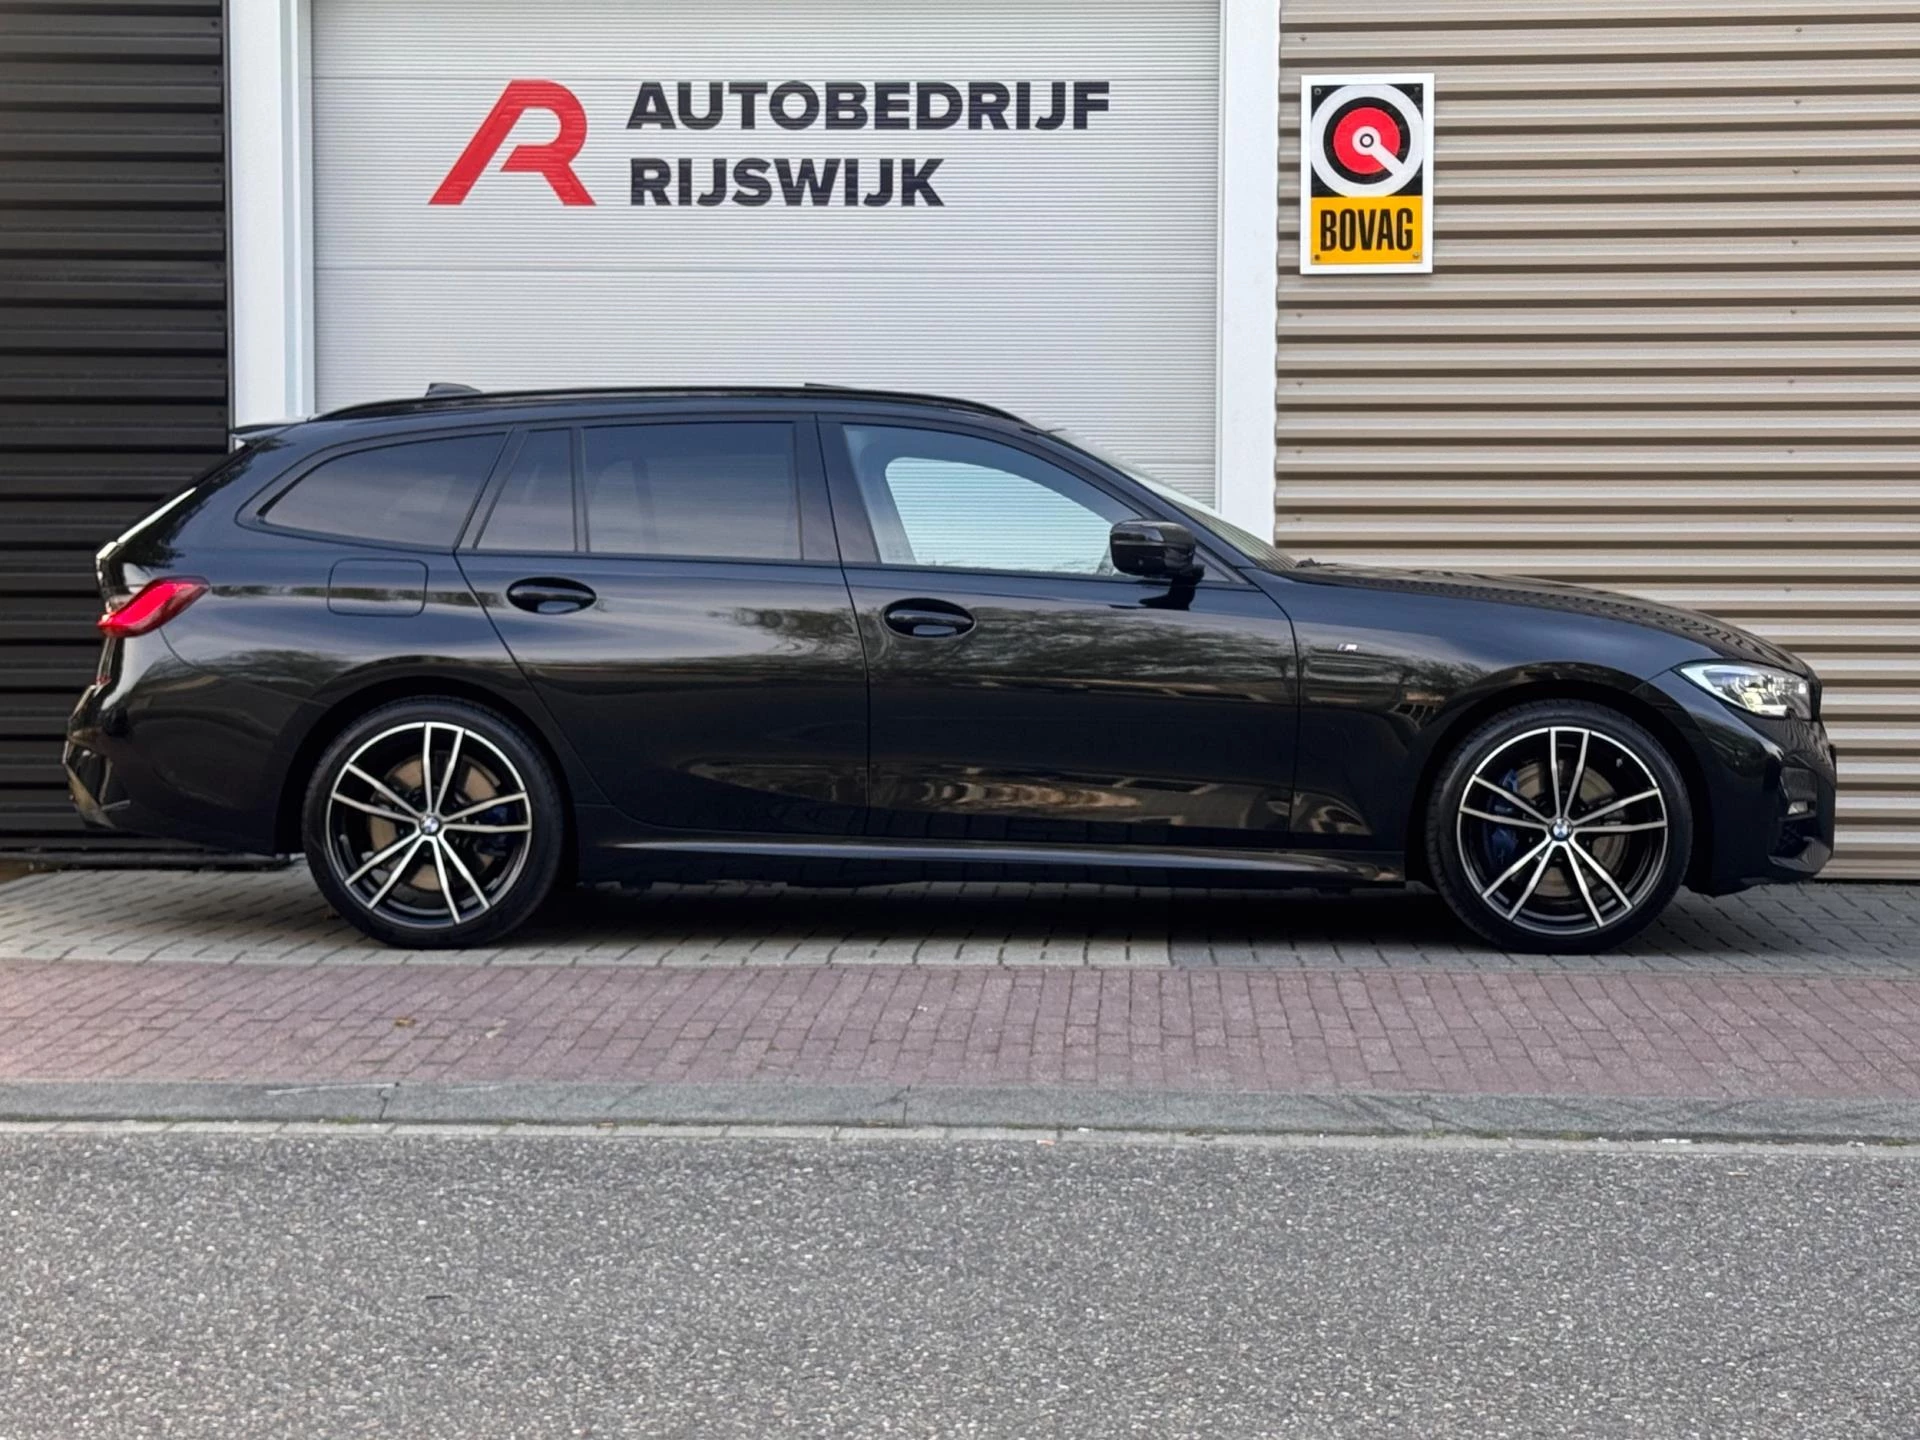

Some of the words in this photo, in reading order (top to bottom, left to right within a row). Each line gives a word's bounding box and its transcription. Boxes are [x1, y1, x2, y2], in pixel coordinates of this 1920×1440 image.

[626, 81, 1110, 131] AUTOBEDRIJF
[630, 157, 945, 207] RIJSWIJK
[1320, 208, 1413, 252] BOVAG
